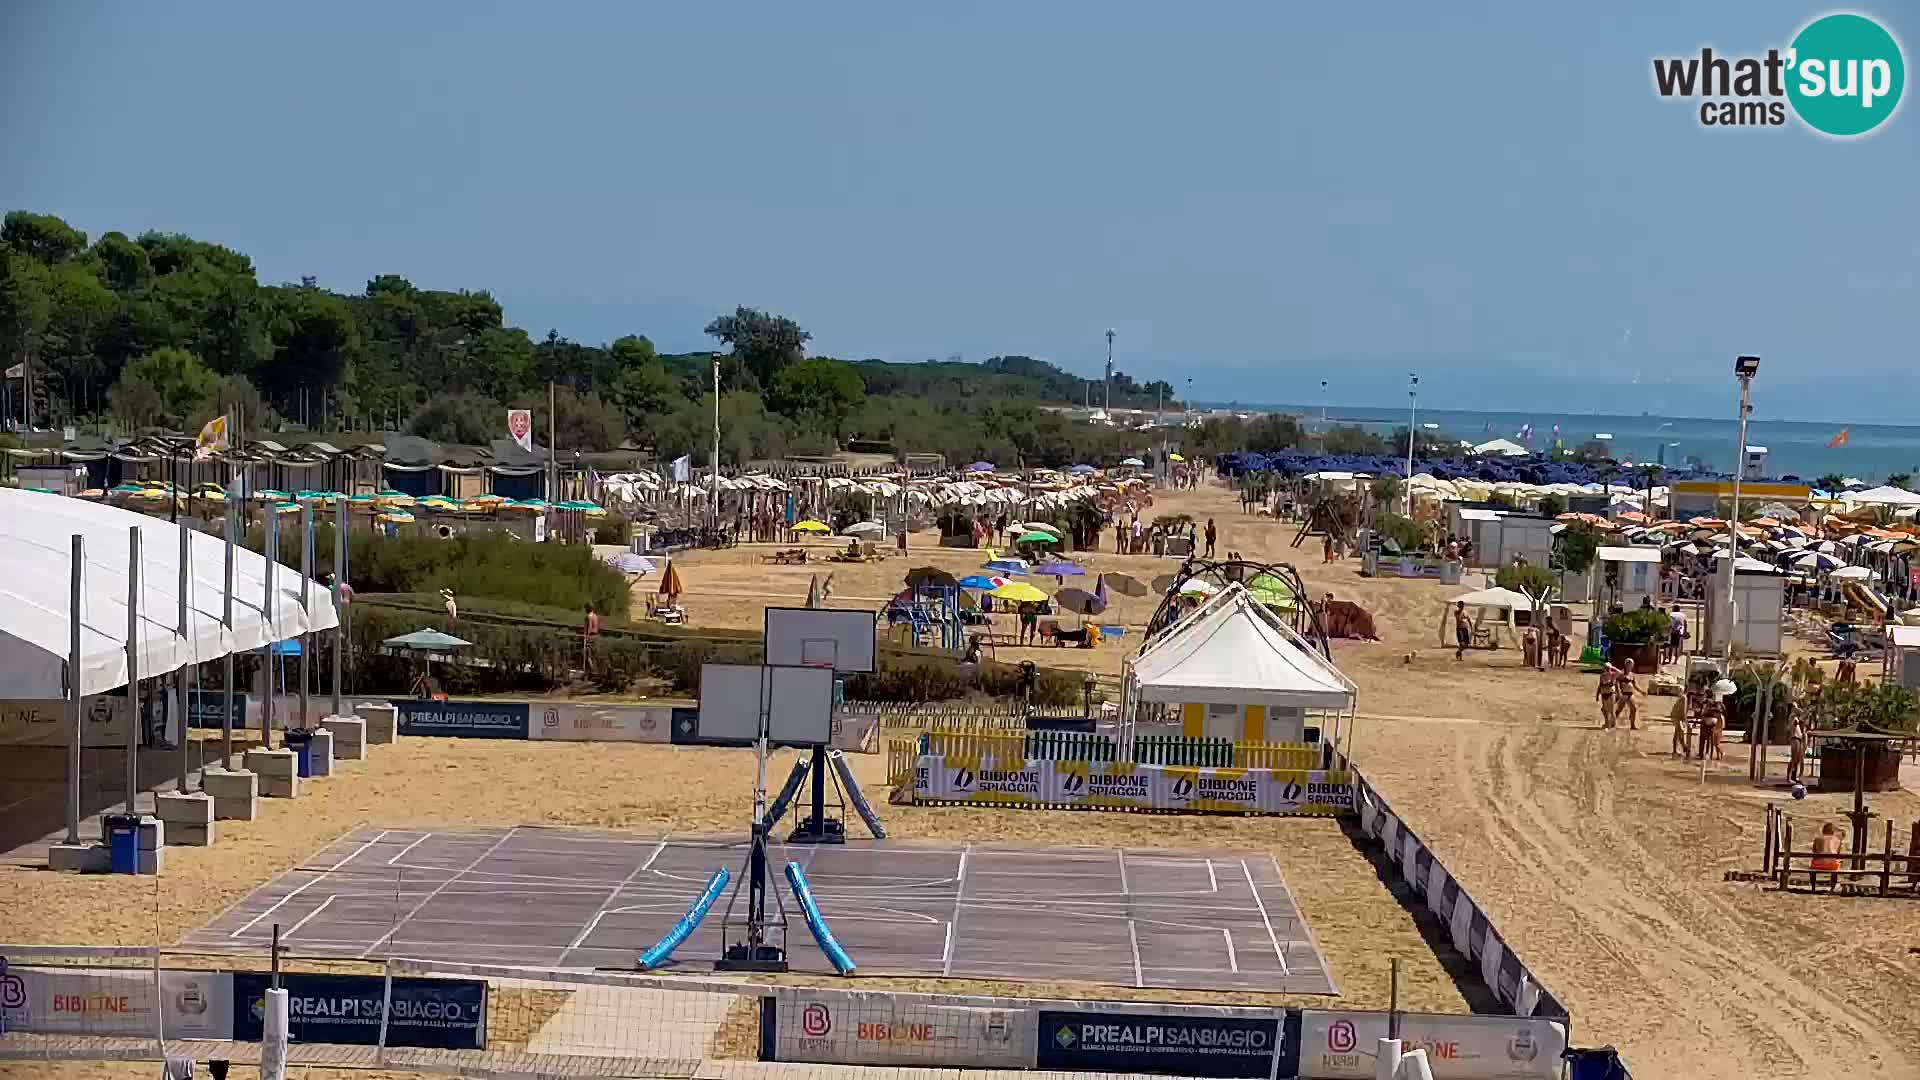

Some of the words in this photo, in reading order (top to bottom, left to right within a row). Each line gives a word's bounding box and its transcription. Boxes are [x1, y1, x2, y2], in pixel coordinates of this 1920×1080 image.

[980, 770, 1039, 783] BIBIONE
[1089, 774, 1148, 787] BIBIONE
[980, 782, 1038, 793] SPIAGGIA
[1199, 778, 1257, 792] BIBIONE
[1307, 783, 1353, 795] BIBION
[1089, 786, 1147, 797] SPIAGGIA
[1199, 790, 1257, 802] SPIAGGIA
[857, 1022, 934, 1041] BIBIONE
